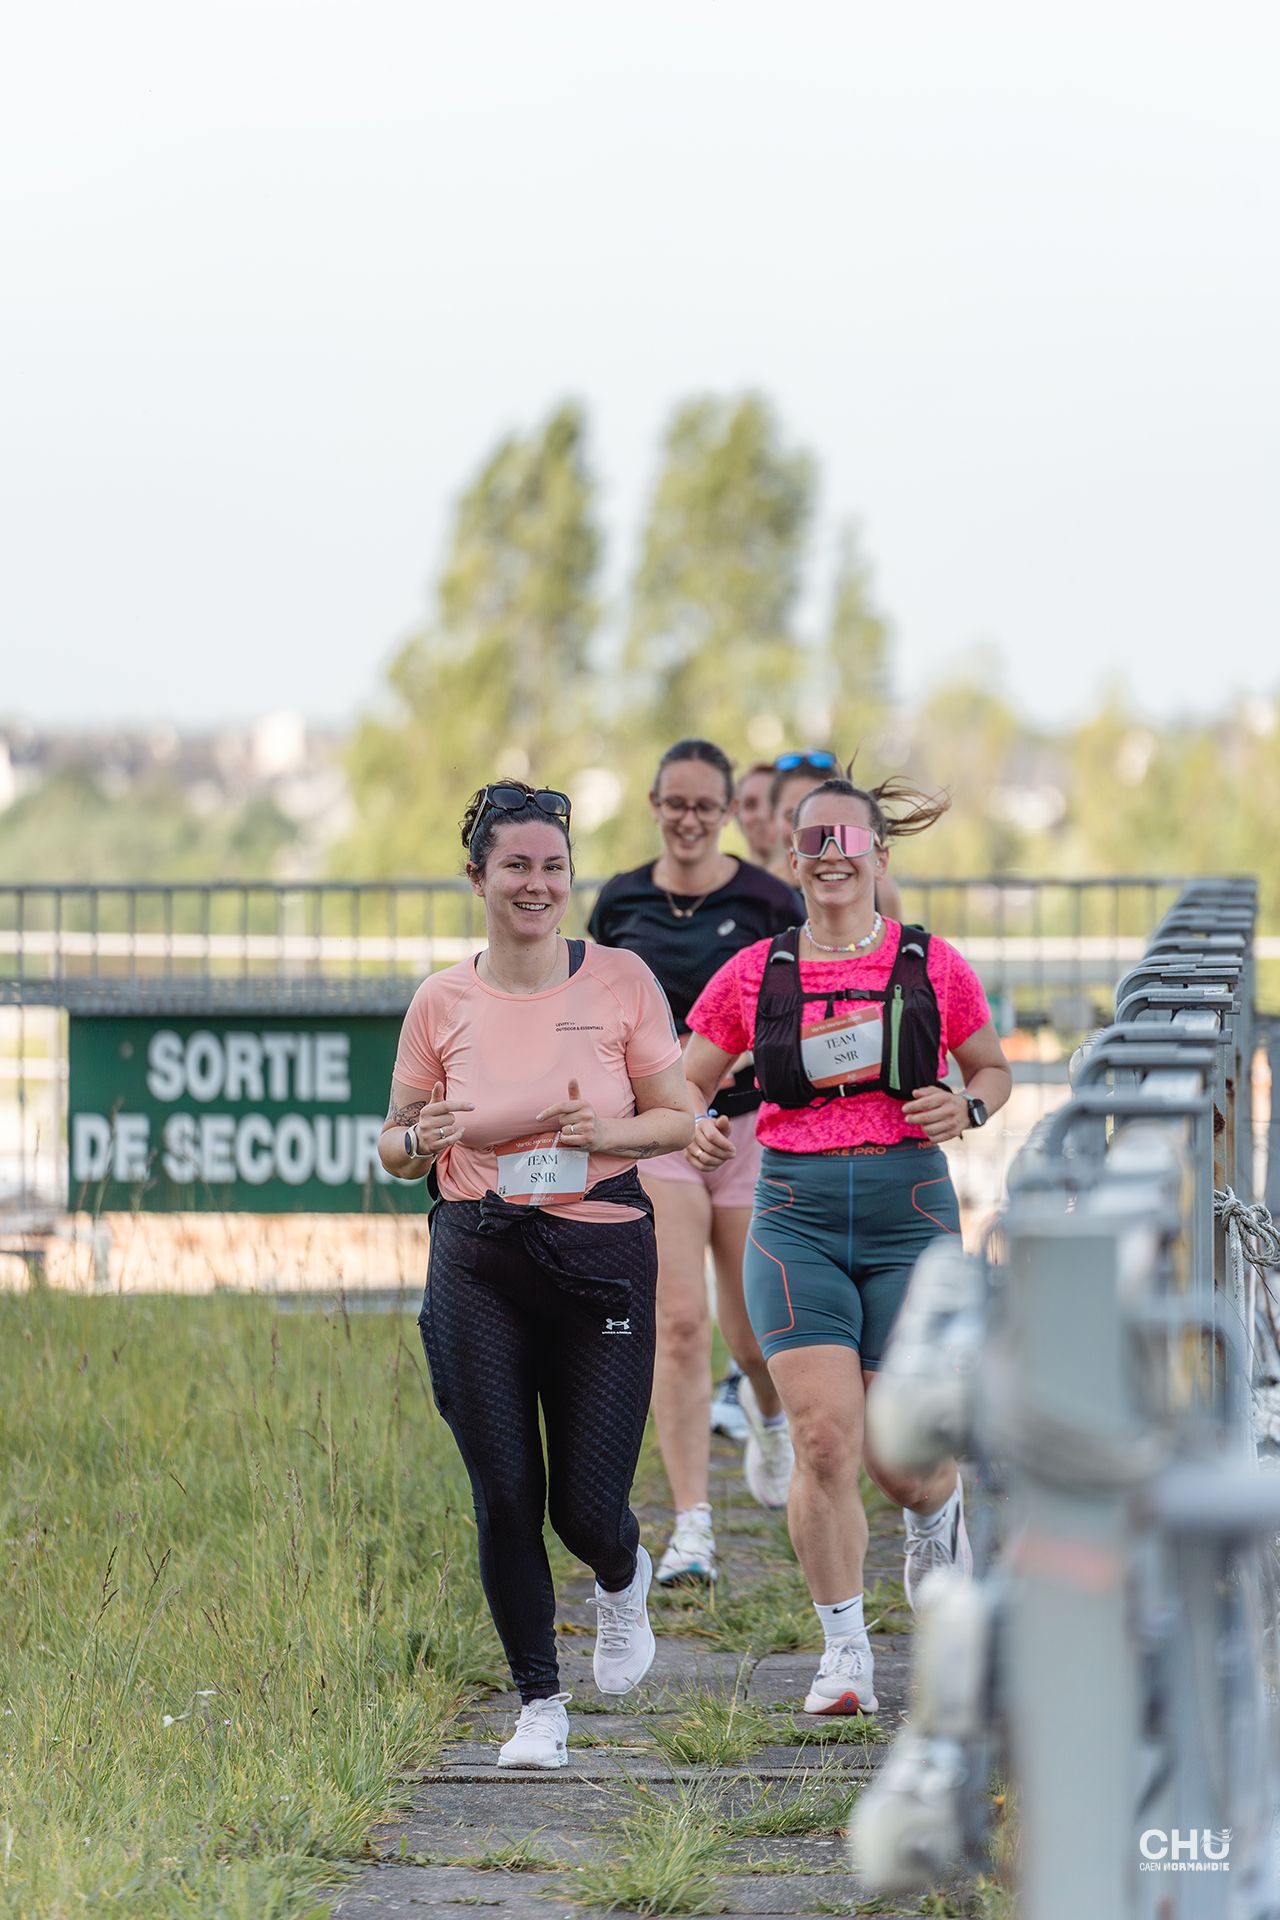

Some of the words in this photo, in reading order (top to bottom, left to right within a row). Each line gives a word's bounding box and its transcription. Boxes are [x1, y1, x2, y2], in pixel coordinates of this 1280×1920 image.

[825, 1033, 857, 1049] TEAM
[833, 1050, 859, 1065] SMR
[147, 1029, 351, 1102] SORTIE
[73, 1113, 150, 1183] DE
[162, 1112, 423, 1186] SECOUR
[853, 1147, 887, 1156] PRO
[528, 1154, 558, 1166] TEAM
[530, 1172, 557, 1183] SMR
